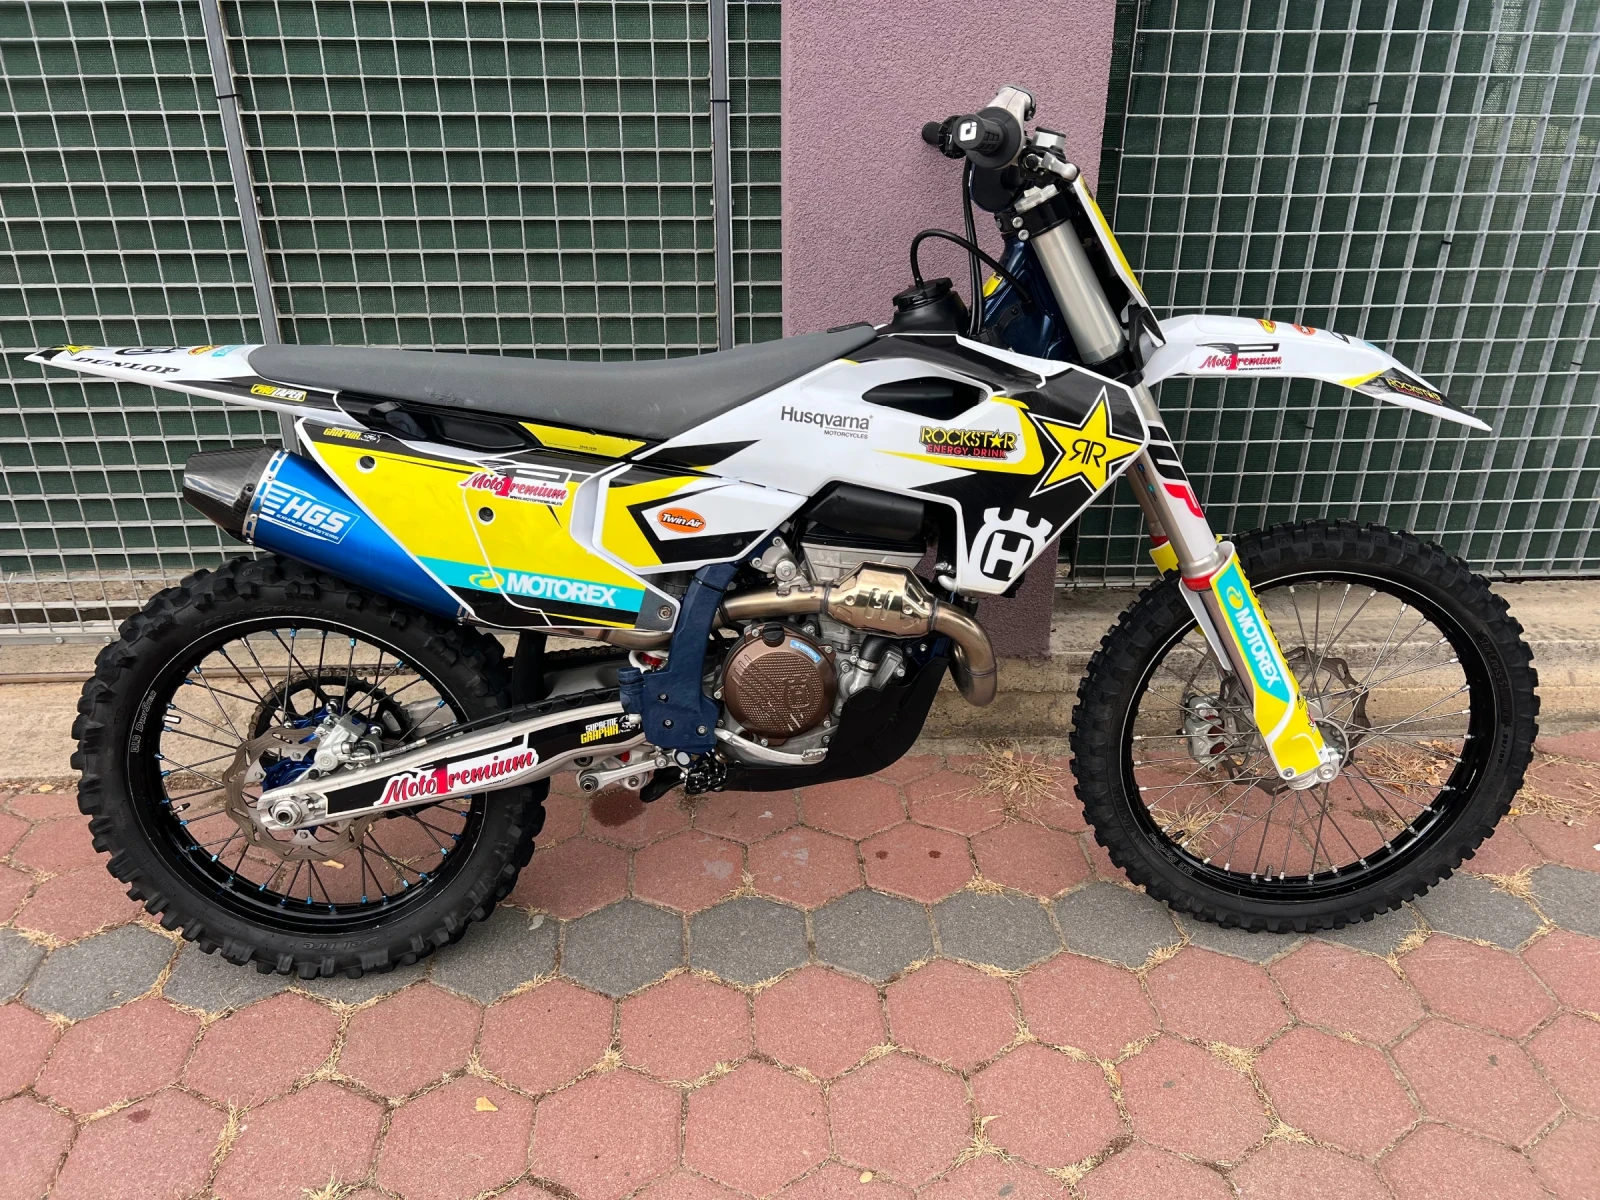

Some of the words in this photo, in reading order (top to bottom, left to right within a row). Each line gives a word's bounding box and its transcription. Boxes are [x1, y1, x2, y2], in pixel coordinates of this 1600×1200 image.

[71, 357, 181, 374] DUNLOP
[781, 405, 870, 430] Husqvarna
[824, 429, 868, 439] MOTORCYCLES
[927, 444, 969, 455] ENERGY
[973, 448, 1006, 458] DRINK
[281, 495, 351, 533] HGS
[662, 513, 686, 526] Twin
[686, 518, 703, 528] Air
[276, 513, 307, 528] EXHAUST
[308, 525, 340, 541] SYSTEMS
[506, 572, 616, 607] MOTOREX
[1235, 607, 1281, 688] MOTOREX
